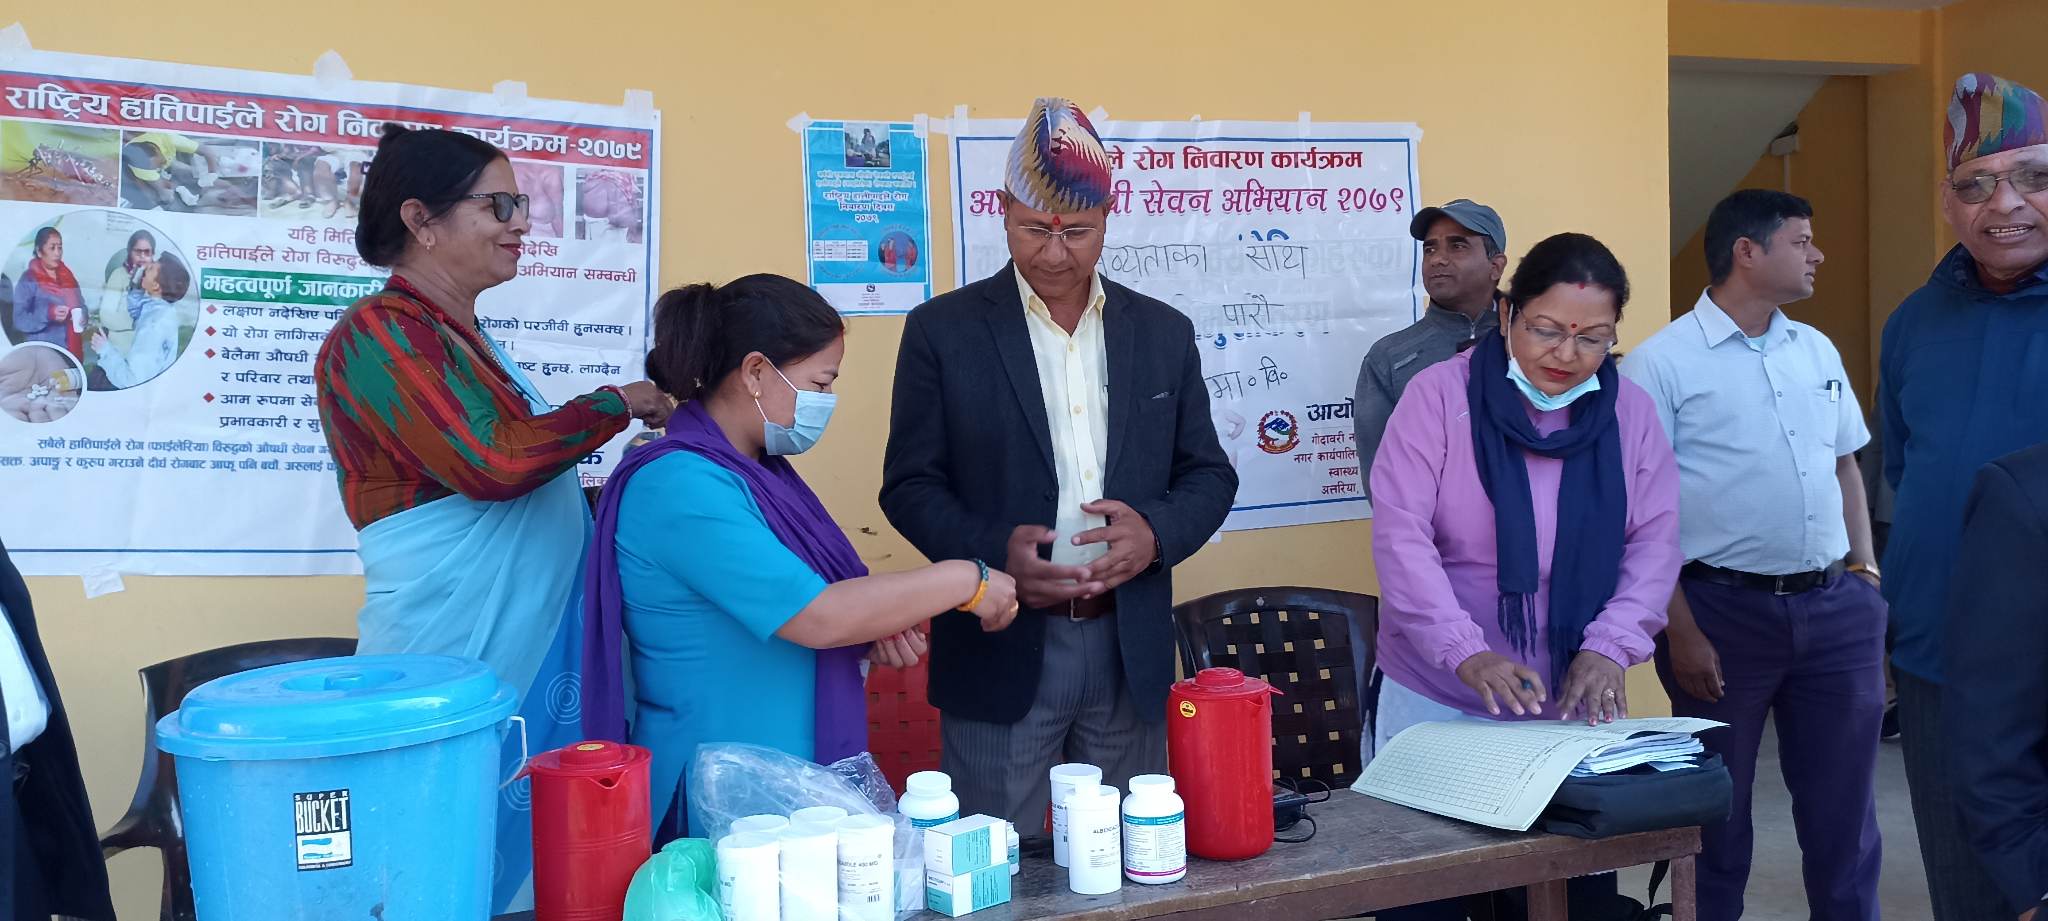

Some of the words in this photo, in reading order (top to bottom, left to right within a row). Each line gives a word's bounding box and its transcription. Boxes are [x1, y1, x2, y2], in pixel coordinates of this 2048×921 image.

[5, 82, 111, 120] राष्ट्रिय
[274, 105, 328, 134] रोग
[1133, 146, 1174, 171] रोग
[1183, 146, 1264, 170] निवारण
[1271, 147, 1363, 170] कार्यक्रम
[1140, 180, 1213, 214] सेवन
[1222, 178, 1328, 213] अभियान
[1338, 187, 1404, 213] २०७९
[288, 225, 318, 244] यहि
[282, 247, 311, 263] रोग
[519, 262, 577, 280] अभियान
[584, 267, 637, 284] सम्बन्धी
[223, 305, 264, 318] लक्षण
[480, 316, 519, 330] रोगको
[524, 318, 569, 332] परजीवी
[222, 324, 239, 338] यो
[244, 325, 268, 339] रोग
[221, 371, 230, 382] र
[235, 370, 282, 384] परिवार
[220, 394, 251, 405] आम
[219, 415, 288, 428] प्रभावकारी
[293, 418, 302, 428] र
[1311, 431, 1345, 446] गोदावरी
[1294, 453, 1313, 464] नगर
[295, 791, 348, 800] SUPER
[295, 797, 349, 834] BUCKET
